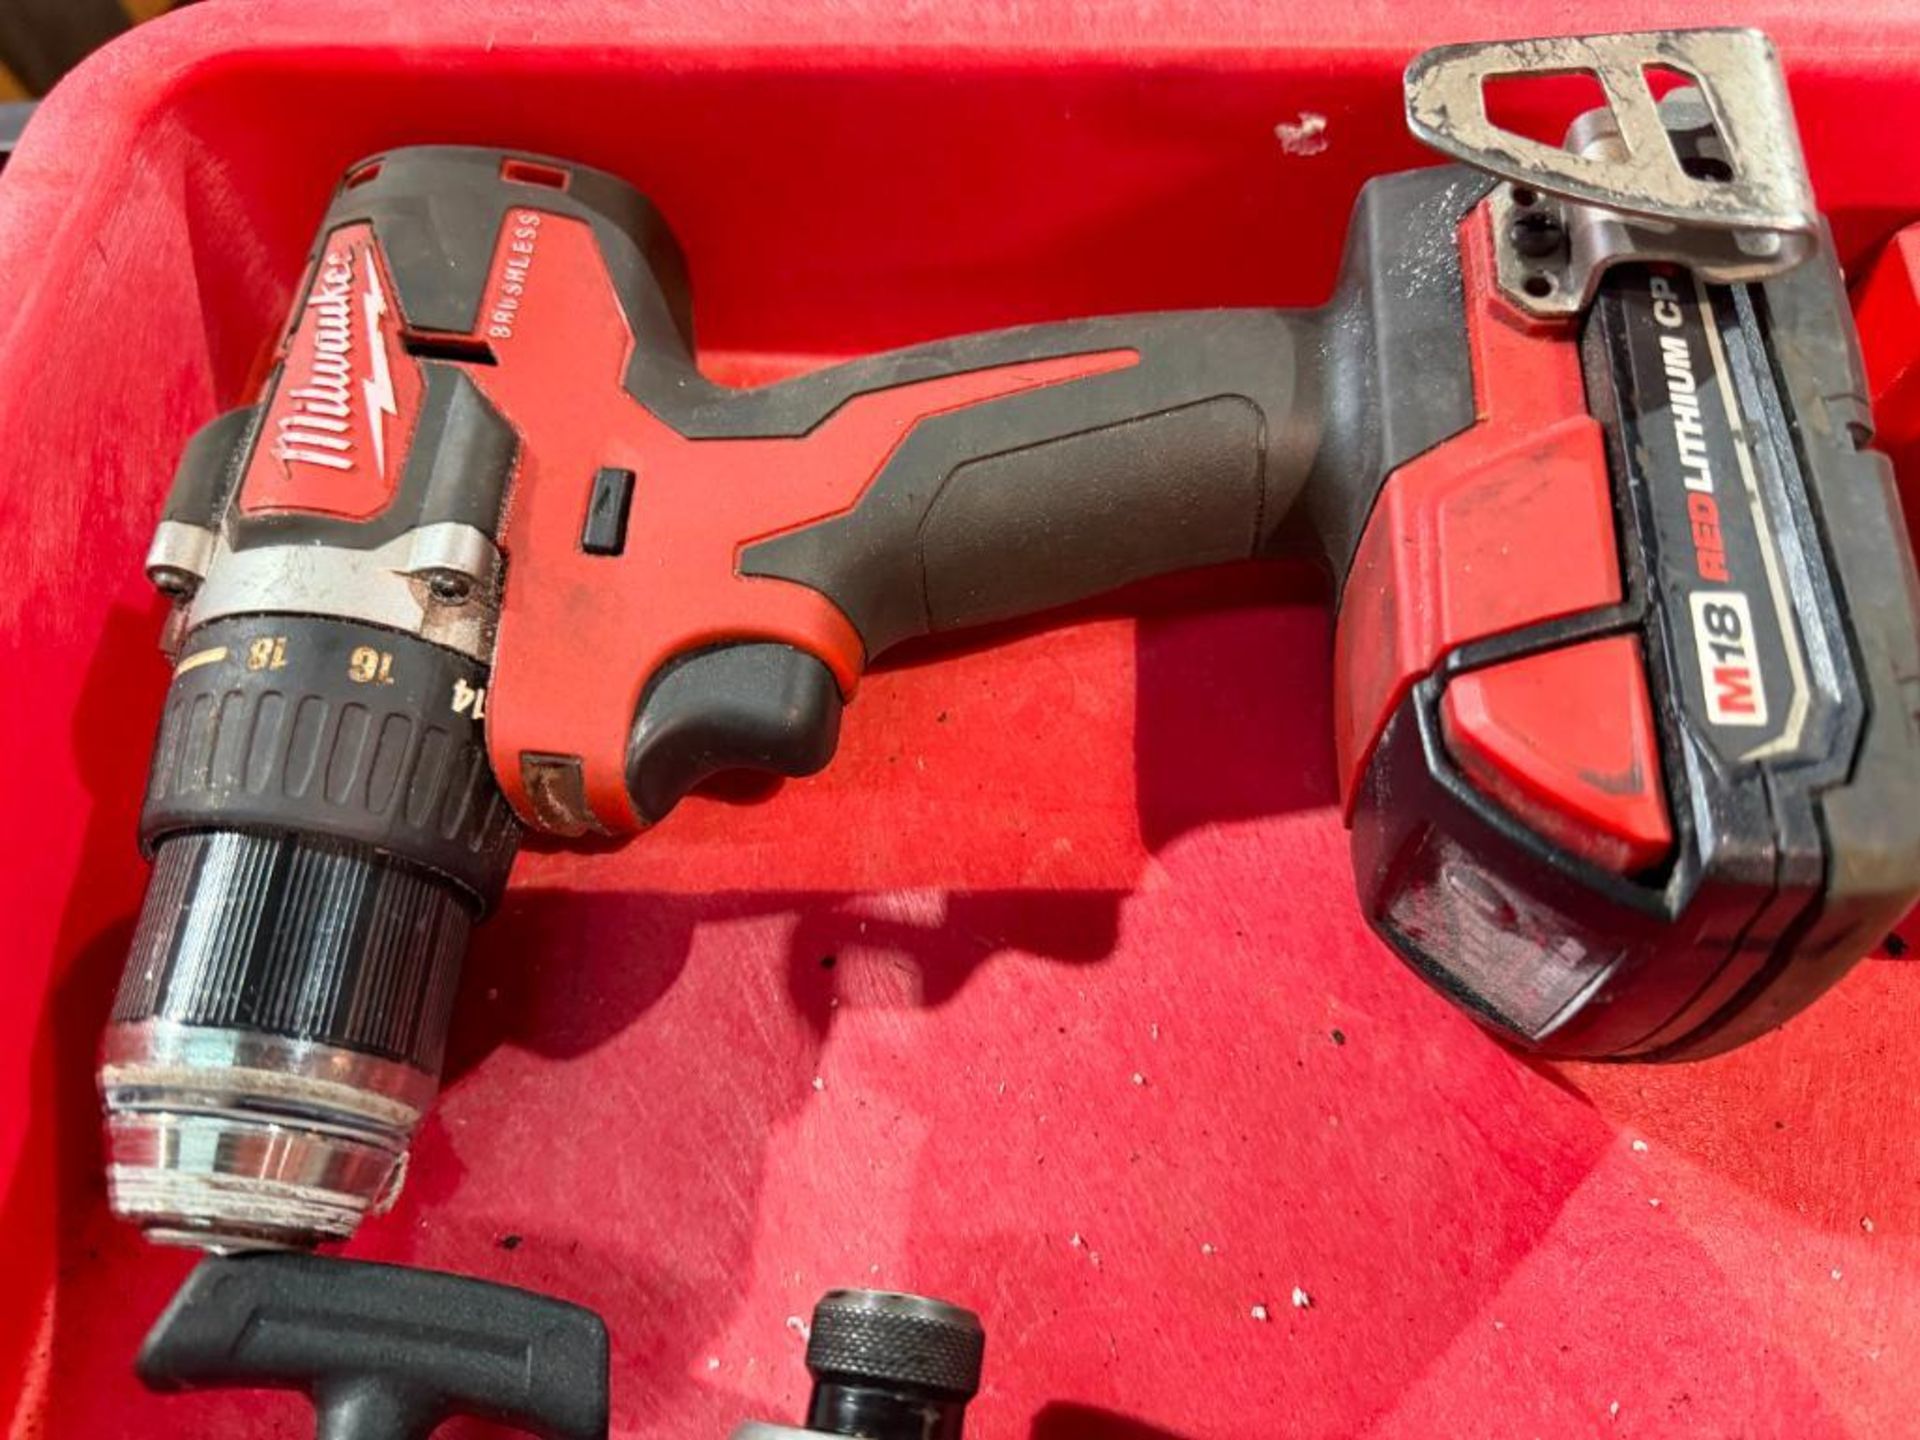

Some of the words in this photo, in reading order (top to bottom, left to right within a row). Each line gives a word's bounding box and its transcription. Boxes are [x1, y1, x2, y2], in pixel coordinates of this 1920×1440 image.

[489, 214, 540, 338] BRUSHLESS
[271, 246, 354, 478] Milwaukee
[247, 636, 288, 671] 18
[350, 646, 394, 685] 16
[1703, 602, 1755, 713] M18
[452, 678, 485, 720] 14
